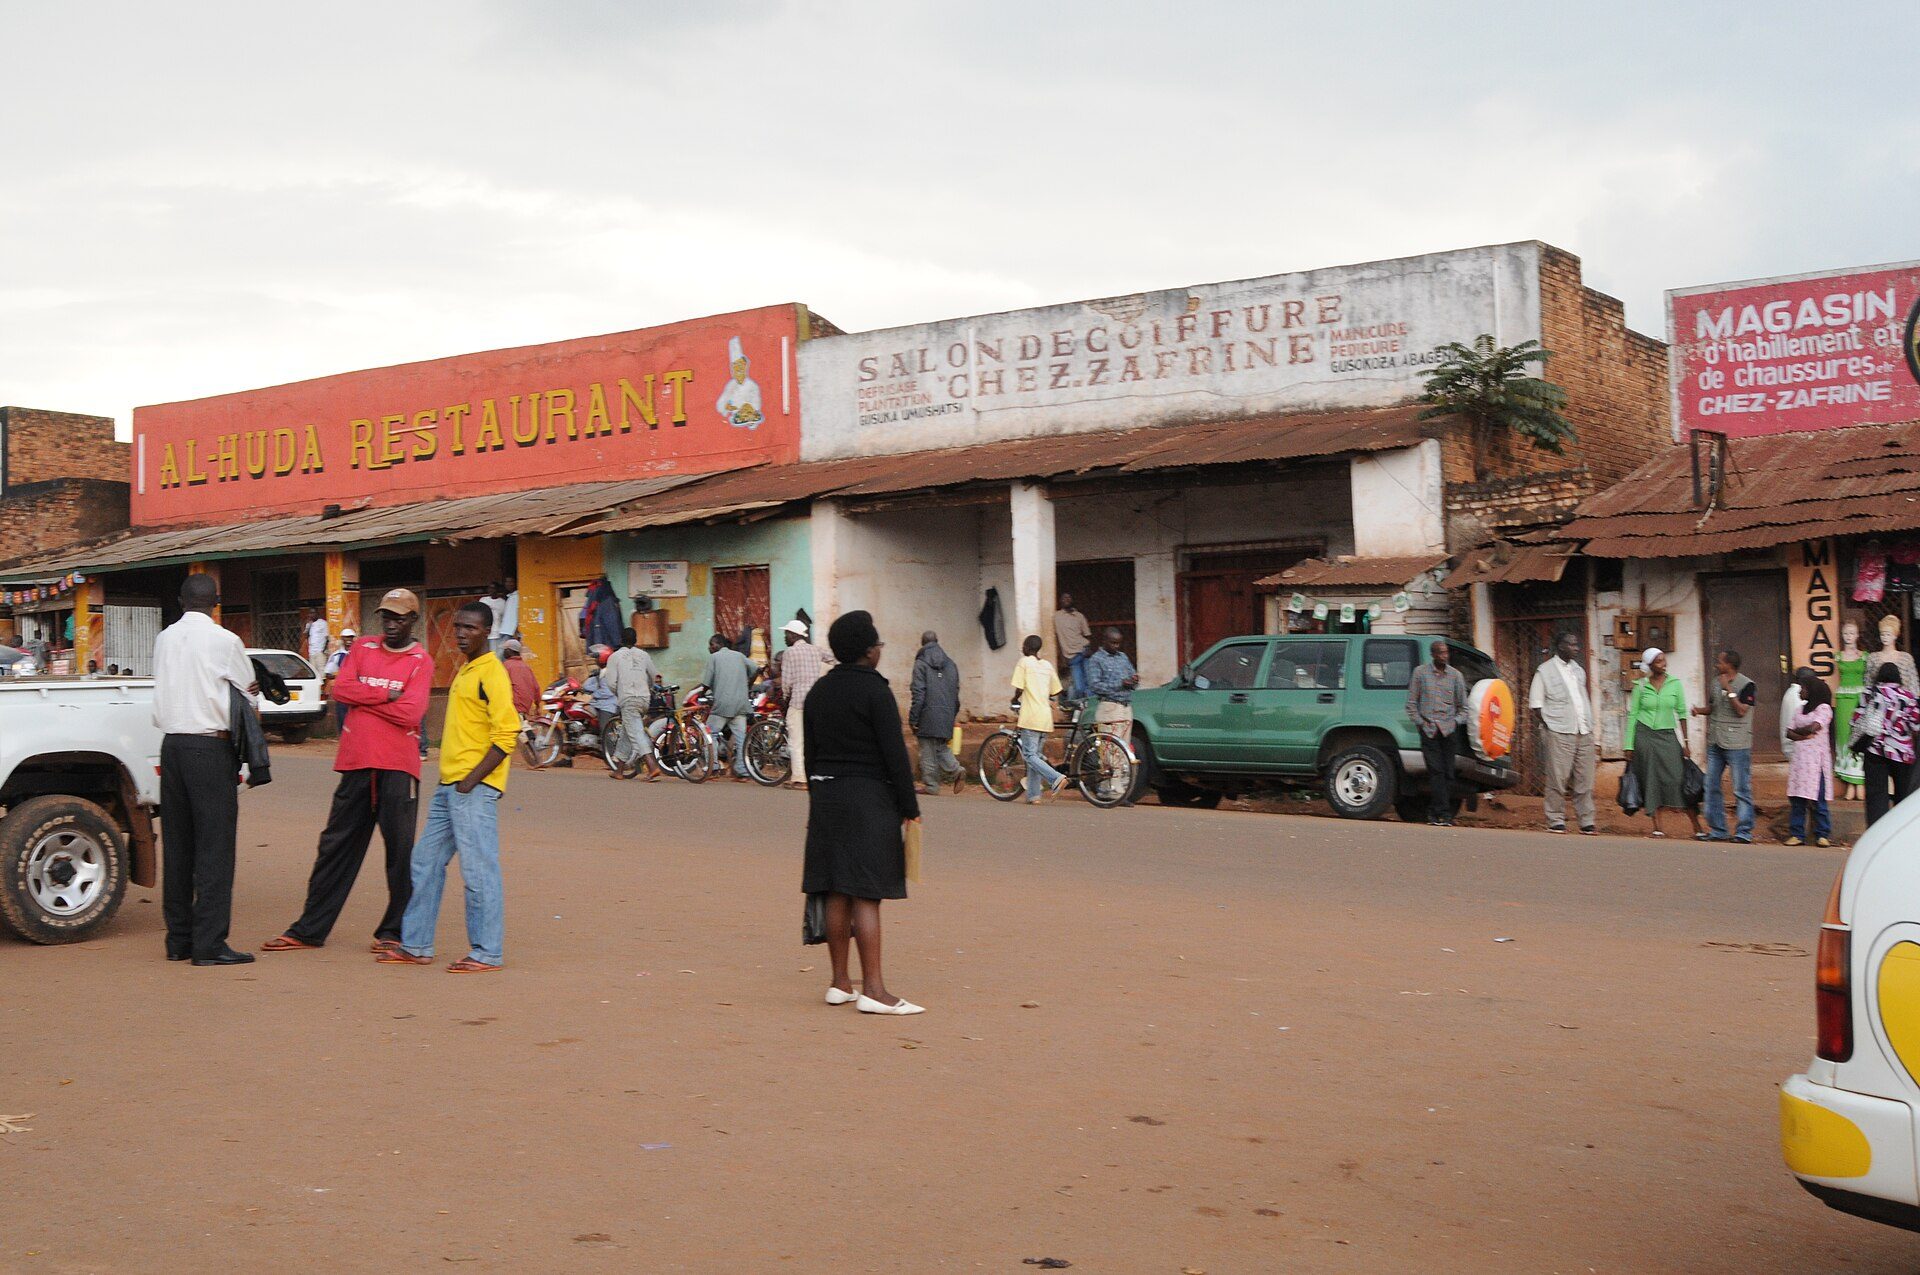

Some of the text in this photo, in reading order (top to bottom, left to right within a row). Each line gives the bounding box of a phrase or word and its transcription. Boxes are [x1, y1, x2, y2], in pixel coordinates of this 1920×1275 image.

[1330, 322, 1408, 341] MANICURE
[1696, 287, 1896, 340] MAGASIN
[858, 294, 1344, 382] SALON DE COIFFURE
[1330, 340, 1400, 357] PEDICURE
[1704, 322, 1904, 365] d'habillement et
[1698, 366, 1725, 391] de
[1734, 355, 1874, 388] chaussures
[1698, 380, 1892, 415] CHEZ-ZAFRINE
[158, 368, 694, 488] AL-HUDA RESTAURANT
